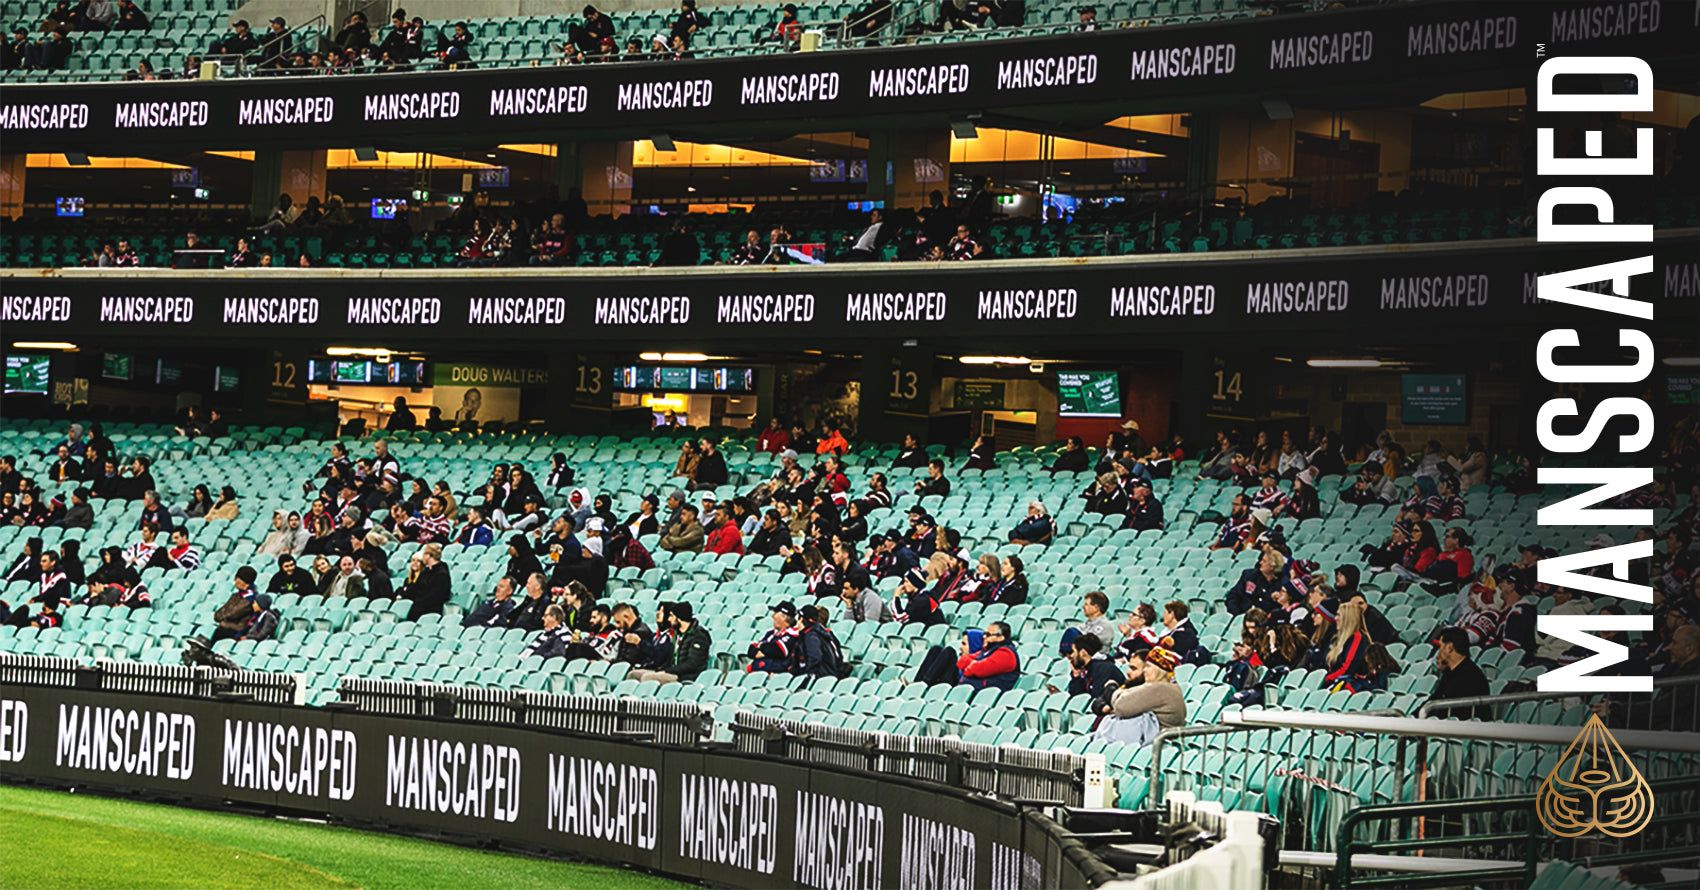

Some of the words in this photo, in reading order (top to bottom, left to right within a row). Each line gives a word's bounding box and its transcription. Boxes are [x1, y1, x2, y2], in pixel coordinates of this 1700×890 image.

[1408, 17, 1516, 56] MANSCAPED
[1552, 0, 1660, 42] MANSCAPED
[1132, 44, 1235, 80] MANSCAPED
[1270, 31, 1372, 69] MANSCAPED
[870, 64, 969, 97] MANSCAPED
[998, 55, 1097, 89] MANSCAPED
[490, 86, 587, 115] MANSCAPED
[618, 80, 712, 110] MANSCAPED
[741, 73, 839, 104] MANSCAPED
[116, 101, 208, 127] MANSCAPED
[239, 97, 333, 124] MANSCAPED
[365, 92, 459, 120] MANSCAPED
[847, 293, 946, 321] MANSCAPED
[978, 289, 1077, 319] MANSCAPED
[1111, 285, 1214, 316] MANSCAPED
[1247, 281, 1348, 313] MANSCAPED
[1381, 275, 1488, 309] MANSCAPED
[101, 297, 193, 322] MANSCAPED
[224, 298, 318, 323] MANSCAPED
[348, 298, 440, 323] MANSCAPED
[469, 298, 565, 323] MANSCAPED
[595, 297, 689, 324] MANSCAPED
[718, 295, 814, 322] MANSCAPED
[271, 361, 296, 388] 12
[452, 366, 488, 383] DOUG
[575, 365, 602, 394] 13
[889, 369, 918, 400] 13
[1212, 369, 1243, 402] 14
[56, 704, 195, 780] MANSCAPED
[223, 719, 357, 800] MANSCAPED
[386, 735, 520, 823] MANSCAPED
[548, 753, 657, 850] MANSCAPED
[680, 774, 777, 874] MANSCAPED
[794, 790, 884, 890] MANSCAPED
